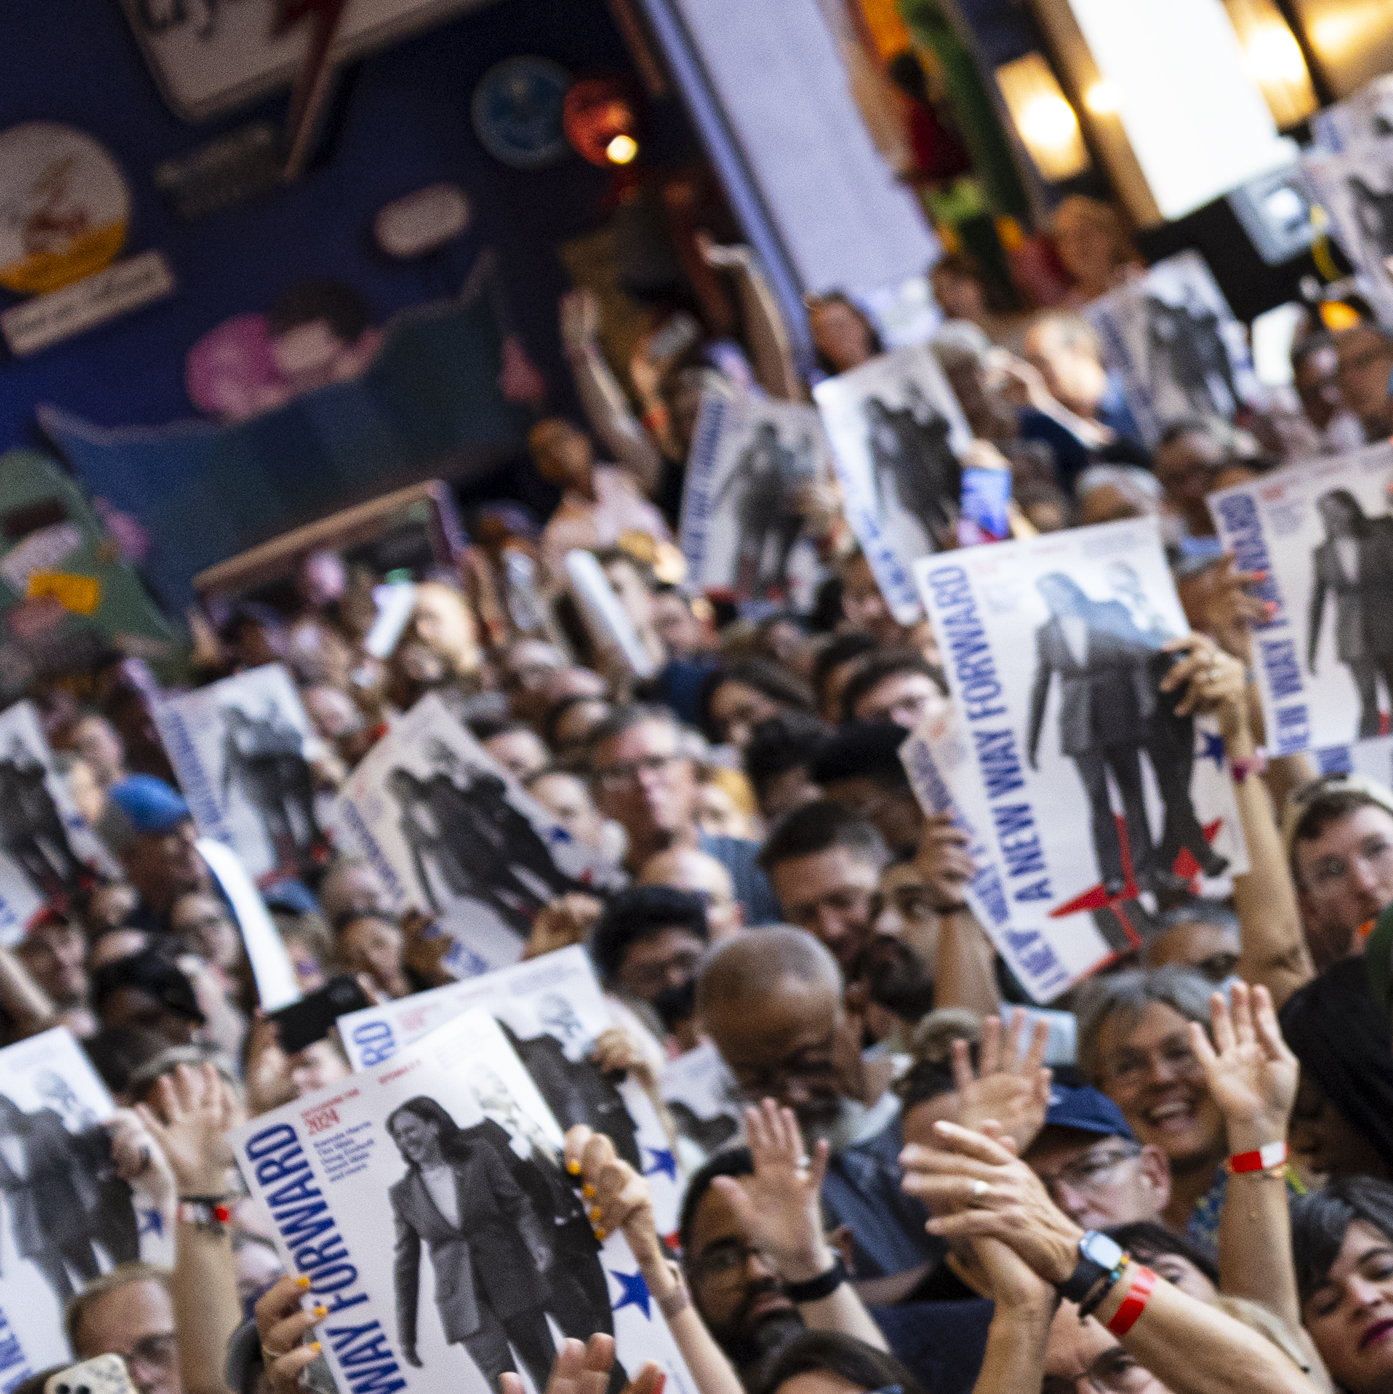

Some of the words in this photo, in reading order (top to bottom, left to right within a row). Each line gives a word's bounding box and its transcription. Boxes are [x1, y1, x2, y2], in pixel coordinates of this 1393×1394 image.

[928, 563, 1008, 722] FORWARD
[971, 727, 1026, 801] WAY
[991, 803, 1047, 879] NEW
[1013, 877, 1054, 903] A
[303, 1107, 341, 1137] 2024
[244, 1122, 370, 1317] FORWARD
